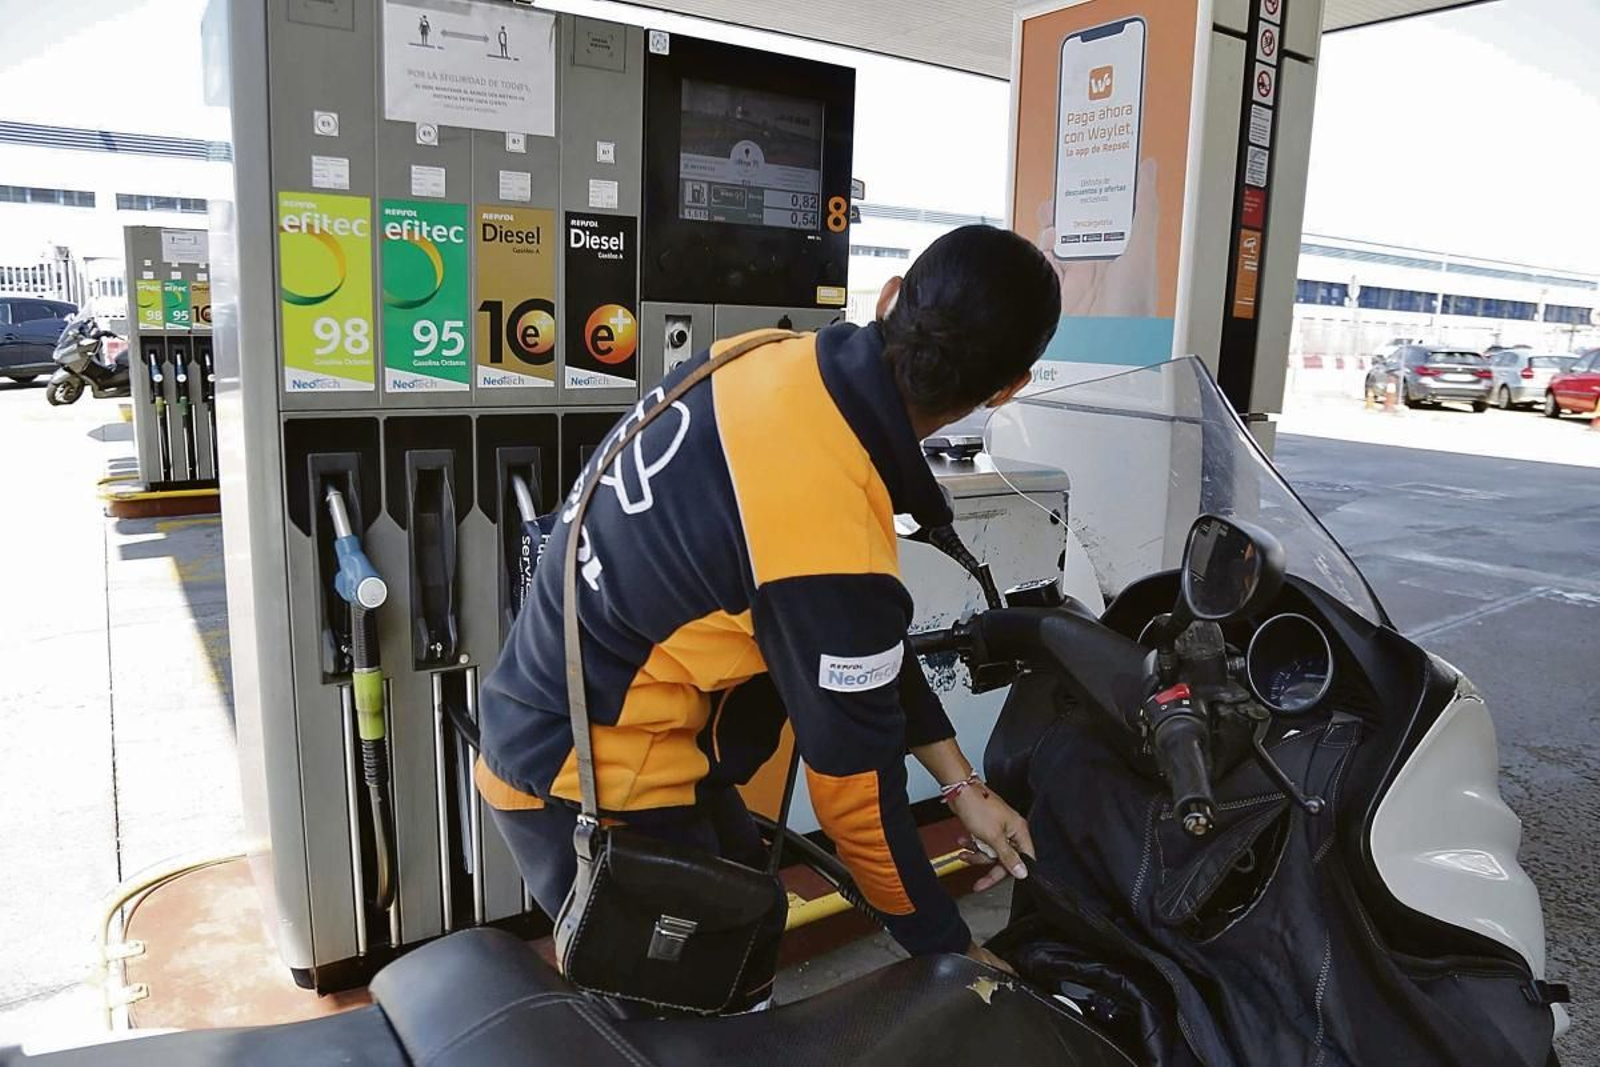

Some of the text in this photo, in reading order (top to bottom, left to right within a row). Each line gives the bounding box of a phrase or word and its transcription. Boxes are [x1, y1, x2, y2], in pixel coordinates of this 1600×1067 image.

[407, 69, 426, 78] POR
[427, 71, 438, 80] LA
[440, 73, 486, 86] SEGURIDAD
[488, 79, 498, 88] DE
[1067, 104, 1132, 126] Paga ahora
[1064, 122, 1134, 144] con Waylet,
[1066, 141, 1130, 158] la app de Repsol
[384, 208, 418, 218] REPSOL
[482, 212, 514, 222] REPSOL
[827, 196, 848, 233] 8
[282, 212, 368, 237] efitec
[384, 220, 464, 244] efitec
[570, 219, 599, 228] REPSOL
[482, 223, 541, 245] Diesel
[570, 228, 624, 250] Diesel
[146, 310, 162, 321] 98
[172, 310, 190, 321] 95
[312, 316, 370, 356] 98
[412, 320, 465, 358] 95
[412, 359, 440, 367] Gasolina
[483, 376, 525, 386] NeoTech
[571, 376, 610, 387] NeoTech
[1032, 366, 1055, 383] ylet
[292, 378, 341, 390] NeoTech
[392, 378, 438, 390] NeoTech
[828, 662, 899, 685] NeoTech
